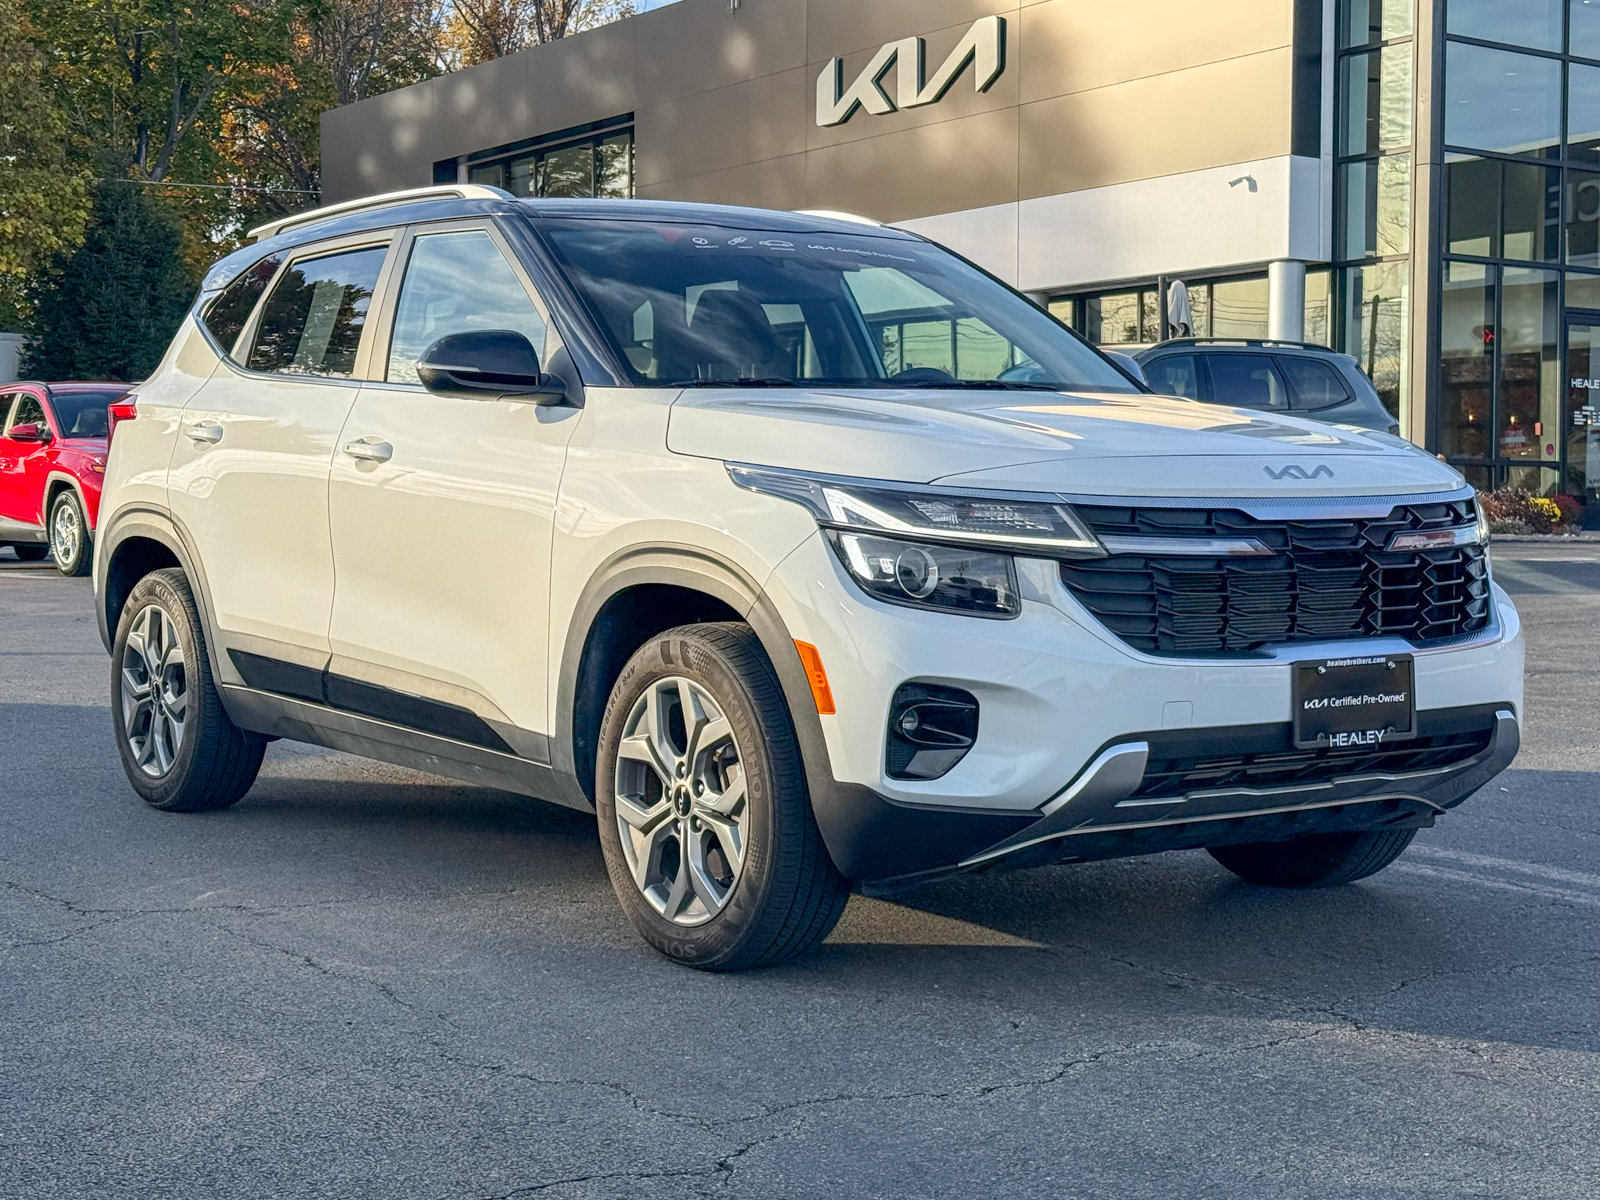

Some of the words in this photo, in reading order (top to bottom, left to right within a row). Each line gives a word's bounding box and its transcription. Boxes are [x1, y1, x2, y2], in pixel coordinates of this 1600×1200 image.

[816, 15, 1006, 127] KIA
[1571, 378, 1600, 389] HEALE
[1262, 464, 1335, 480] KIA
[1326, 656, 1386, 667] healeybrothers.com
[1304, 698, 1328, 710] KIA
[1330, 695, 1361, 708] Certified
[726, 691, 763, 799] KUMHO
[1329, 729, 1385, 748] HEALEY
